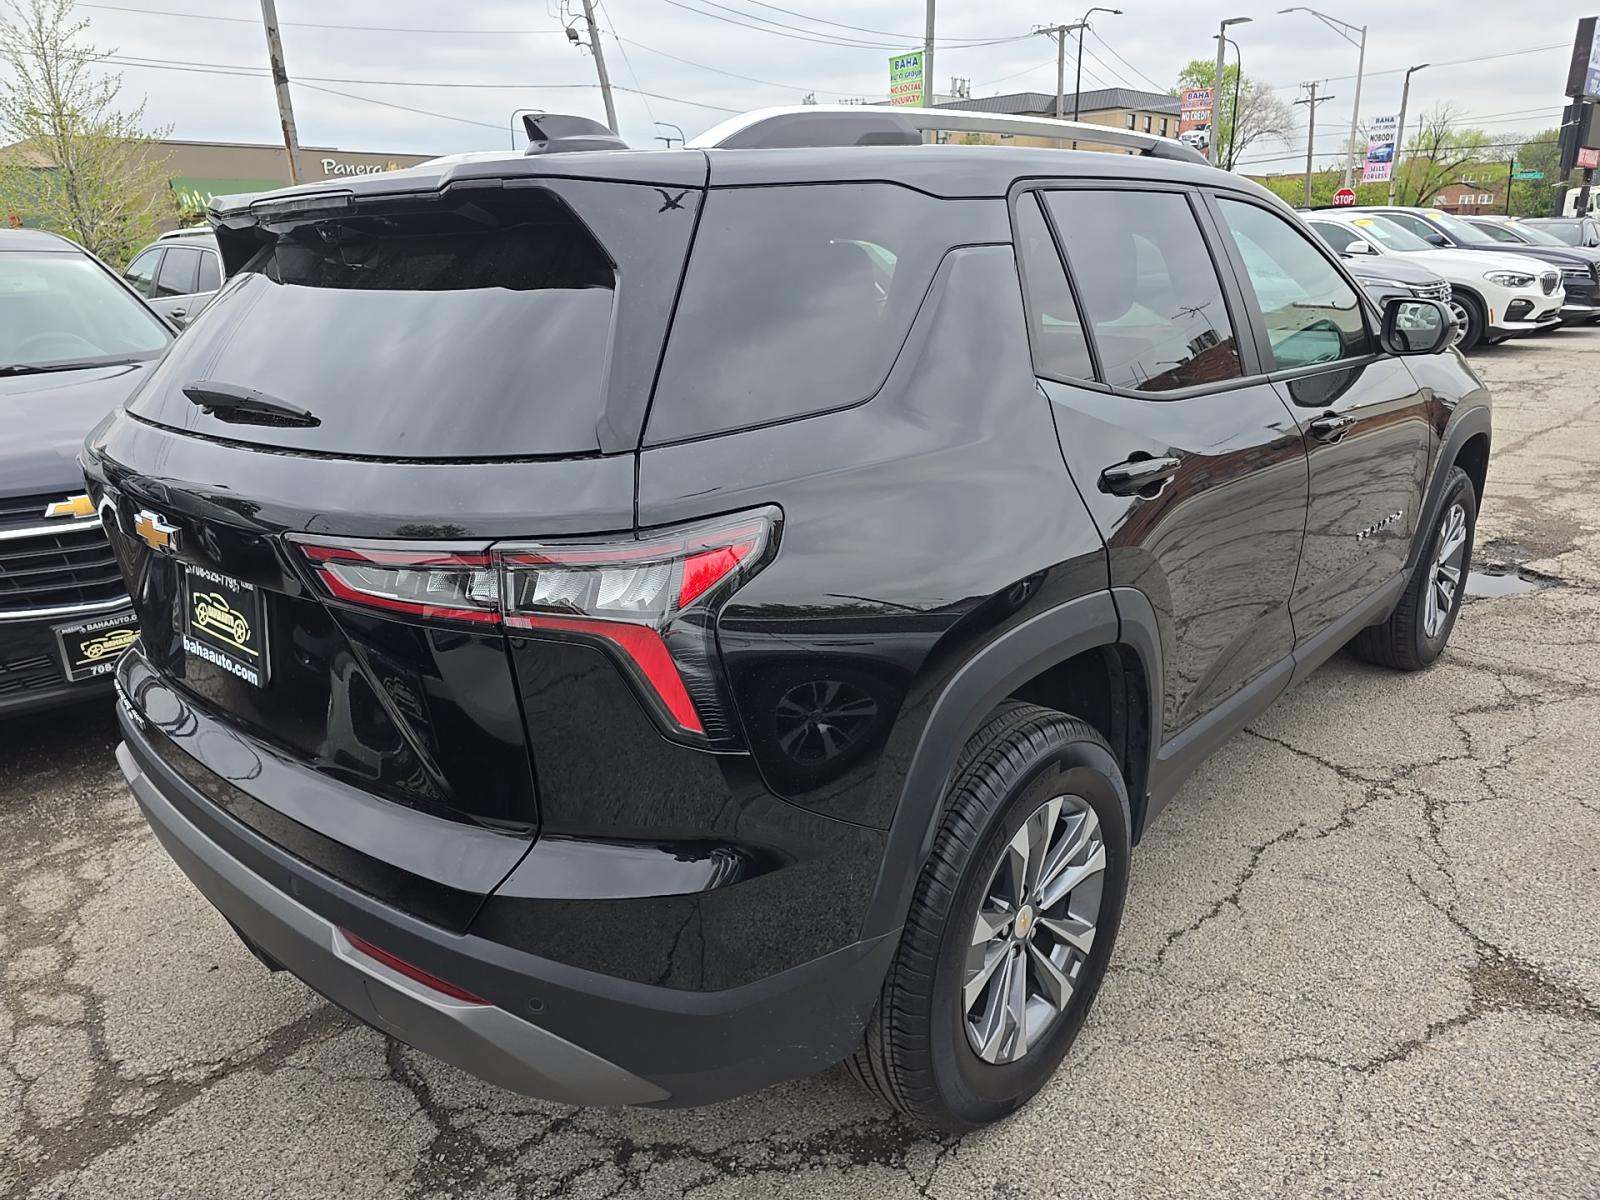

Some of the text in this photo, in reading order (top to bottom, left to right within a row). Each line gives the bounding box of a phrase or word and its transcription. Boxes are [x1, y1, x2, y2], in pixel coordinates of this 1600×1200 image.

[894, 56, 918, 70] BAHA
[1187, 91, 1209, 100] BAHA
[1181, 110, 1210, 121] NO CREDIT
[1370, 133, 1394, 142] NOBODY
[321, 158, 382, 175] Panera
[1334, 194, 1354, 205] STOP
[182, 634, 258, 686] bahaauto.com
